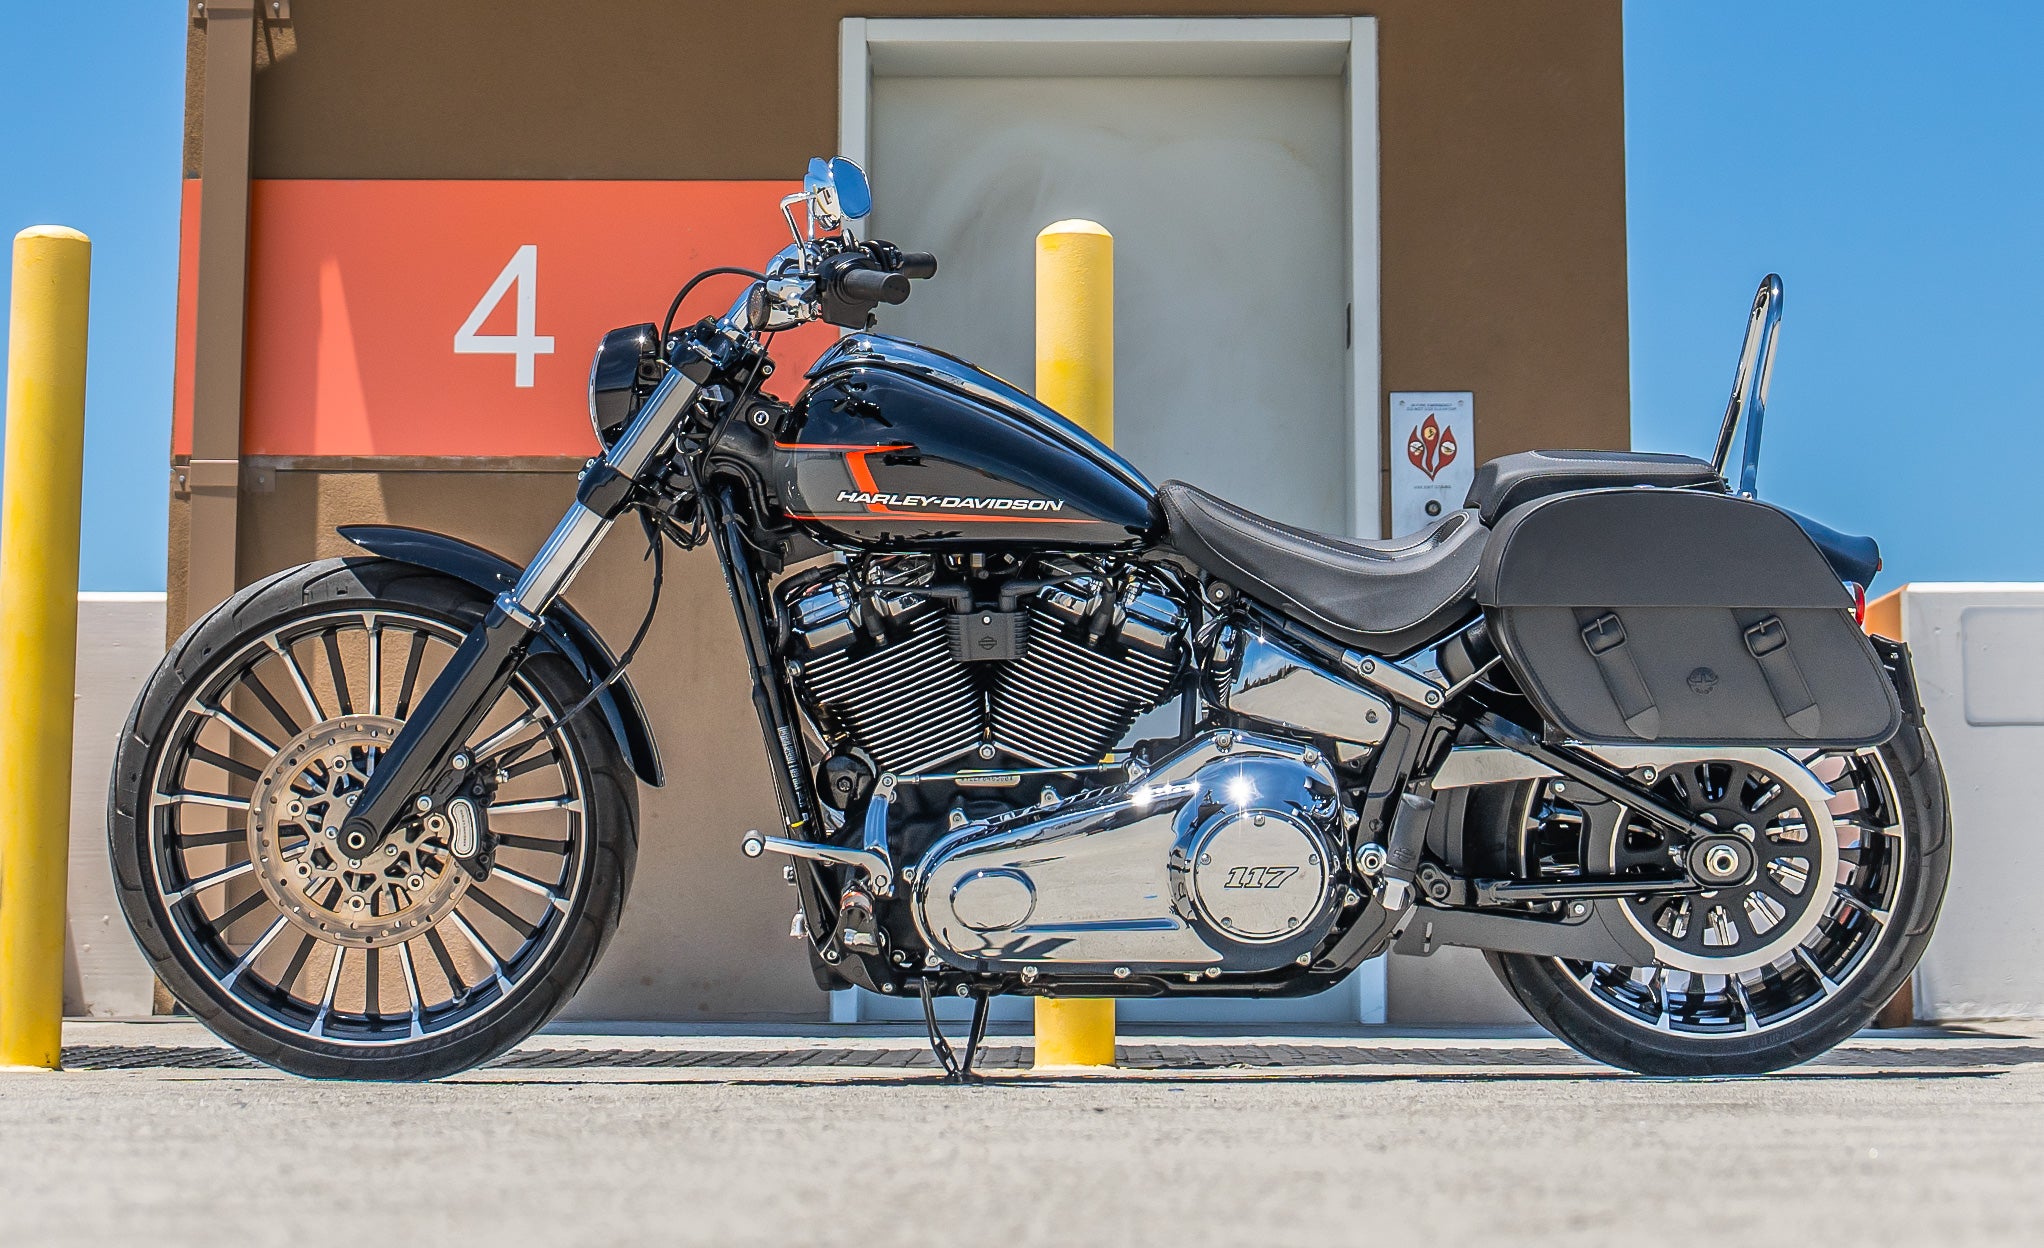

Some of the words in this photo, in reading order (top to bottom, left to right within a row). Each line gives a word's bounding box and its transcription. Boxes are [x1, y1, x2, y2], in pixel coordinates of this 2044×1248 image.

[454, 244, 555, 388] 4
[836, 490, 1064, 512] HARLEY-DAVIDSON
[1223, 866, 1300, 889] 117
